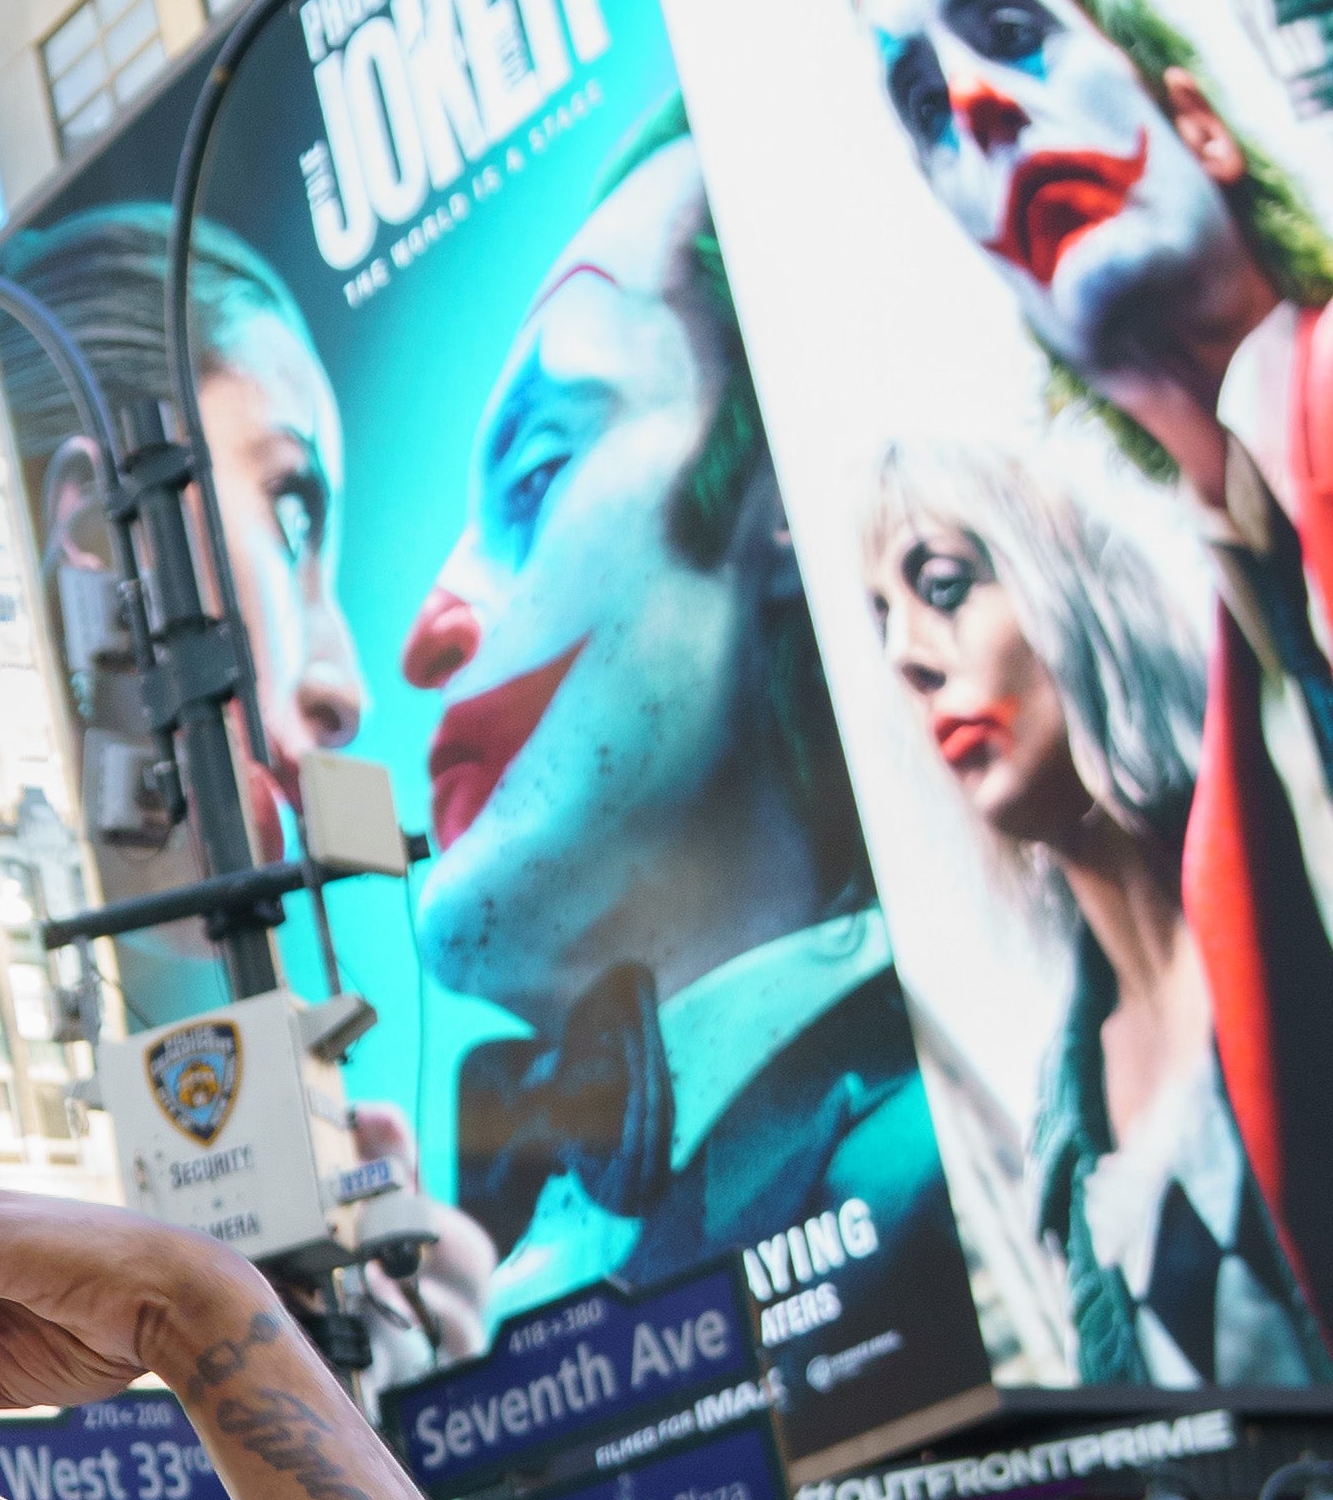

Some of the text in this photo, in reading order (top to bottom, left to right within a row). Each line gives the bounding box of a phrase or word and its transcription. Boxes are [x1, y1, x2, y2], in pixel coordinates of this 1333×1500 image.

[342, 257, 389, 309] THE
[389, 191, 471, 269] WORLD
[505, 146, 526, 173] A
[528, 77, 603, 154] STAGE
[169, 1143, 255, 1190] SECURITY
[339, 1157, 391, 1196] NYPD
[415, 1340, 619, 1470] Seventh
[631, 1308, 729, 1390] Ave
[657, 1409, 697, 1444] FOR
